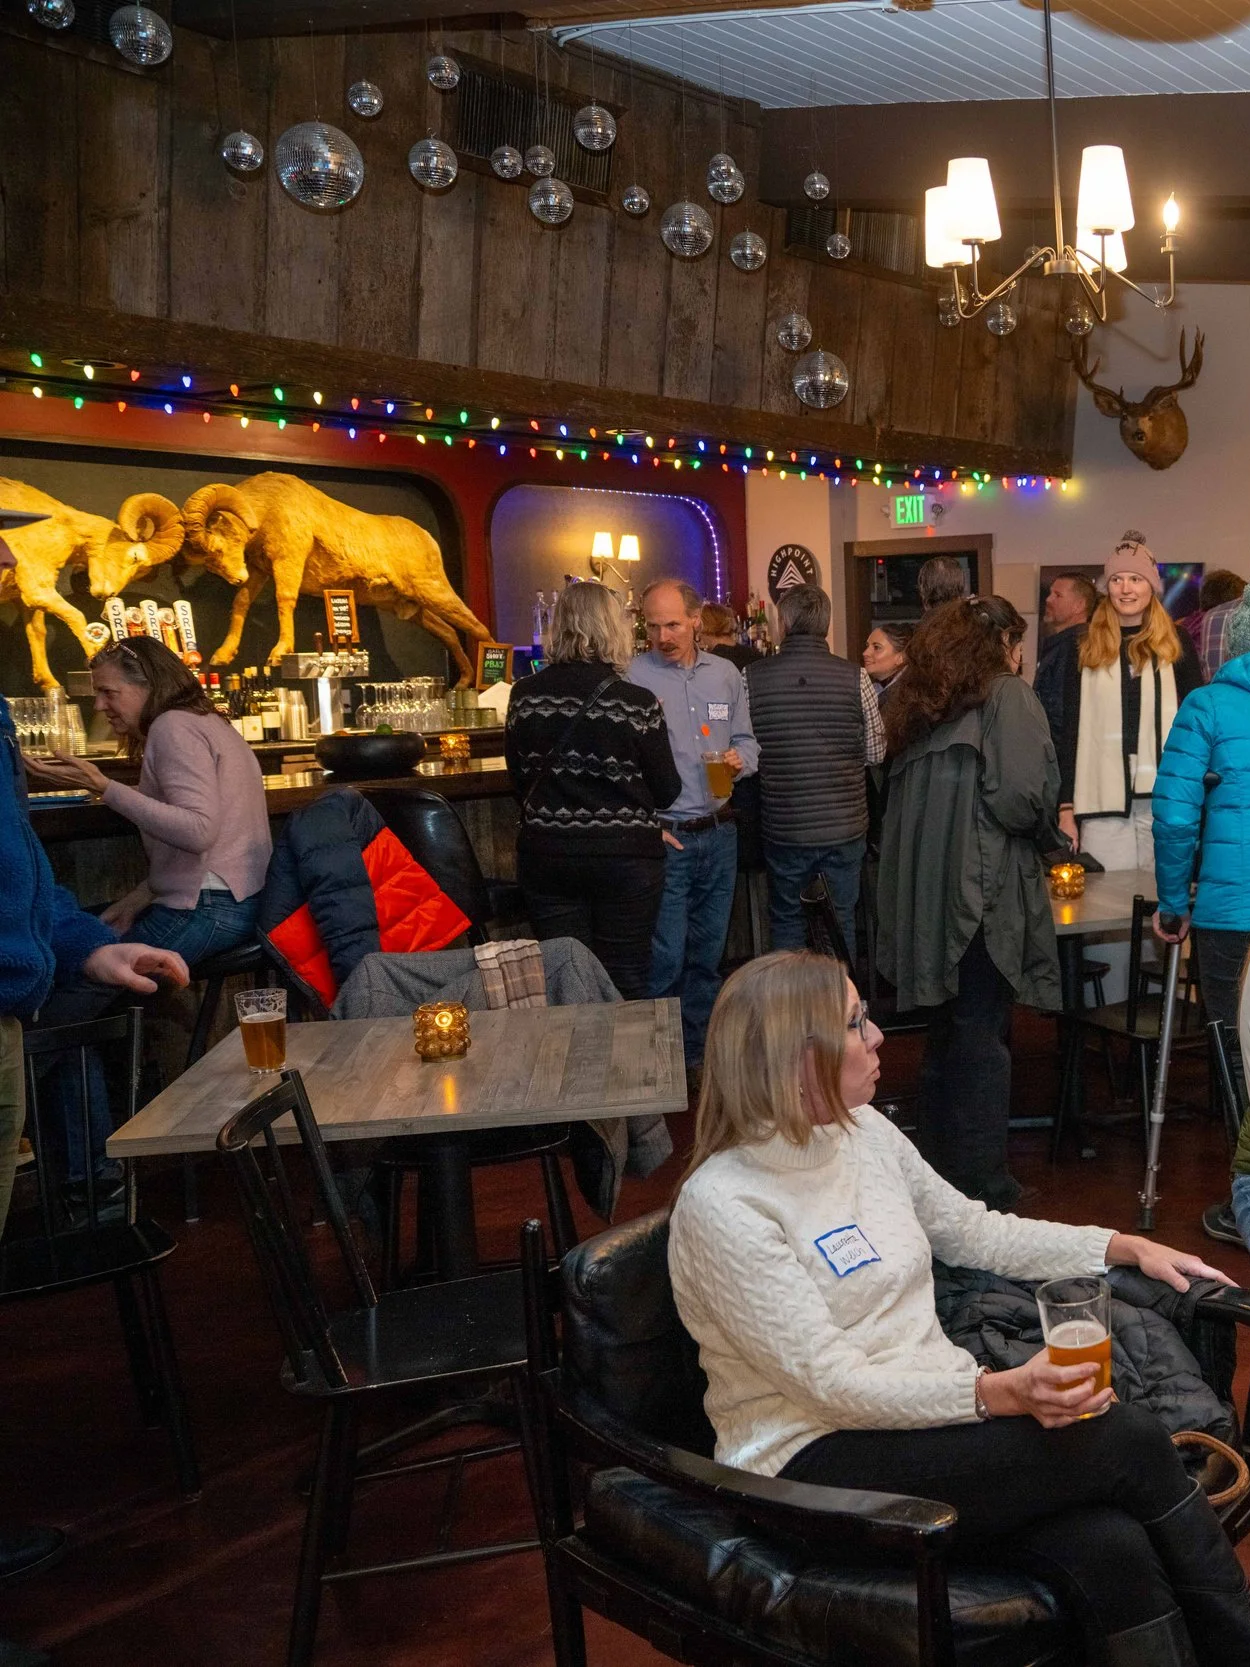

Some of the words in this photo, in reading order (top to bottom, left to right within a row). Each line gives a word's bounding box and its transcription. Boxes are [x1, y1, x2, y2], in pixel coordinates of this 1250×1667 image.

[896, 495, 925, 525] EXIT
[770, 547, 813, 577] HIGHPOINT
[111, 604, 126, 641] SRB
[147, 604, 161, 640] SRB
[180, 604, 194, 640] SRB
